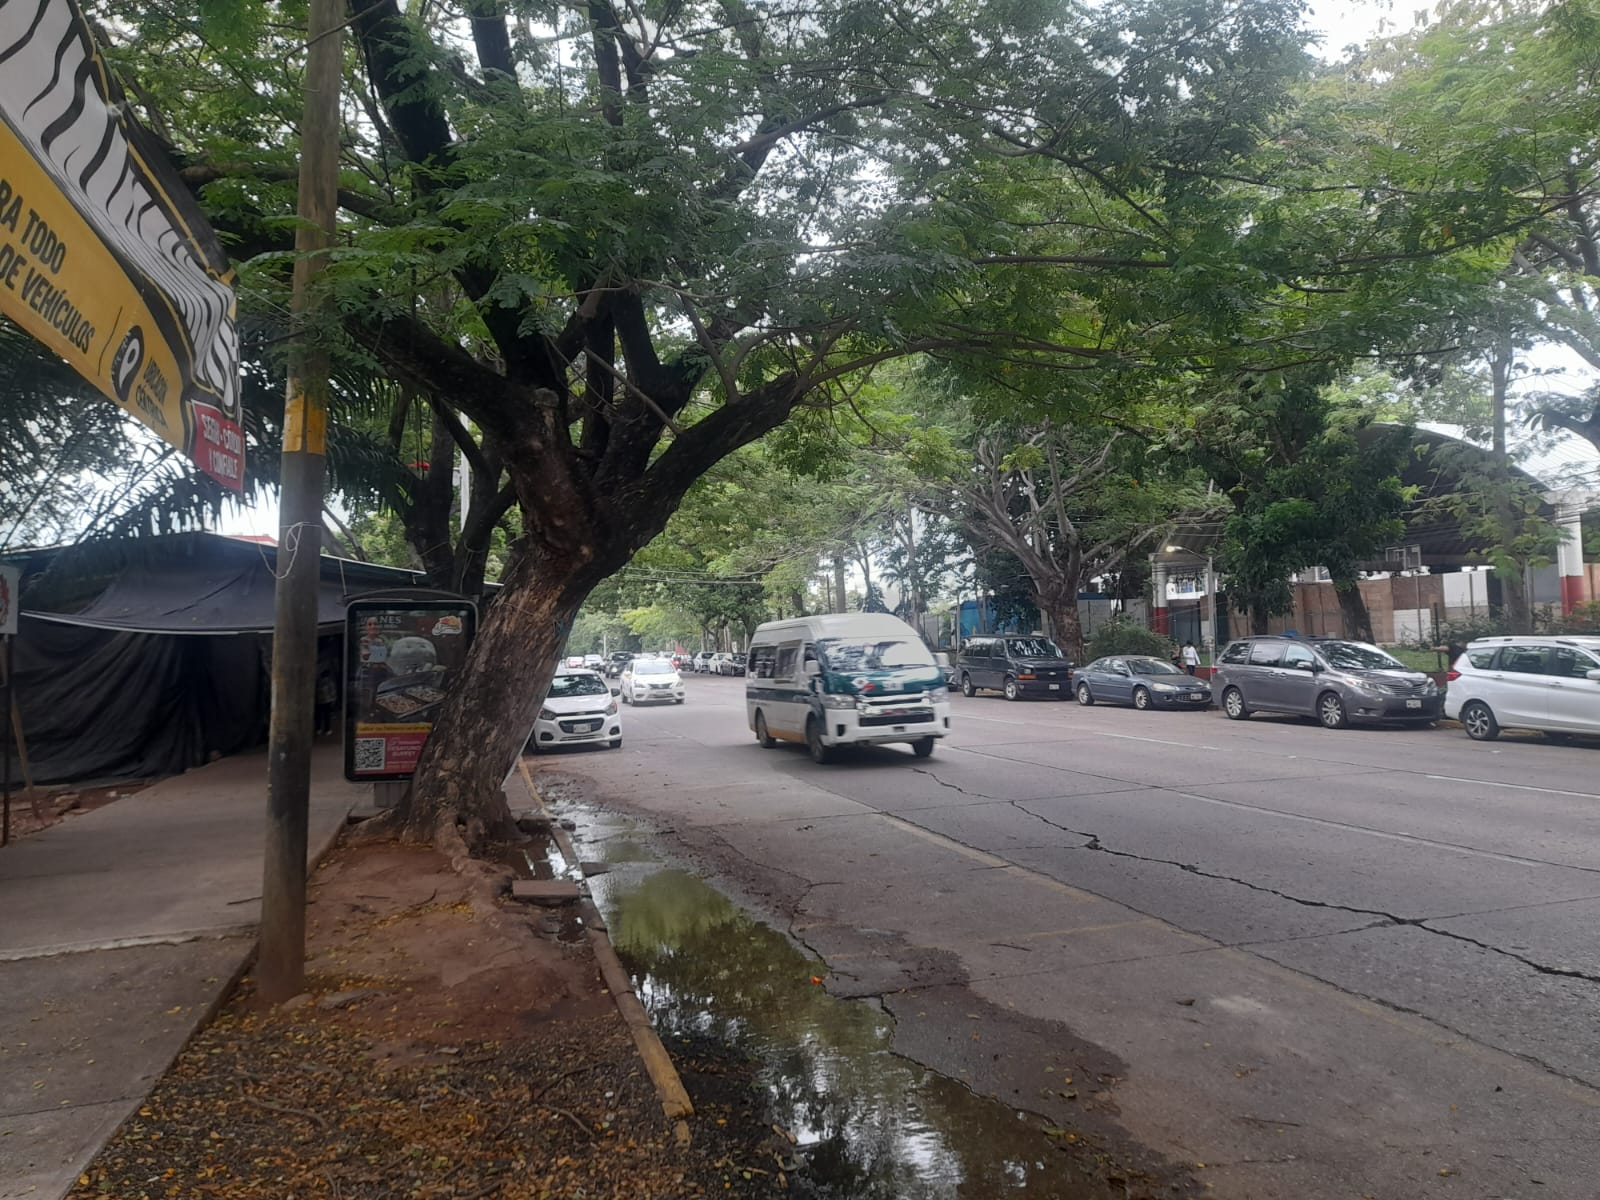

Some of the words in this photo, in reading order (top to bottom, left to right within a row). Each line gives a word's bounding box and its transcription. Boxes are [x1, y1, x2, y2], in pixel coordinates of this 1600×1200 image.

[21, 207, 67, 275] TODO
[0, 242, 28, 291] DE
[21, 266, 96, 355] VEHÍCULOS
